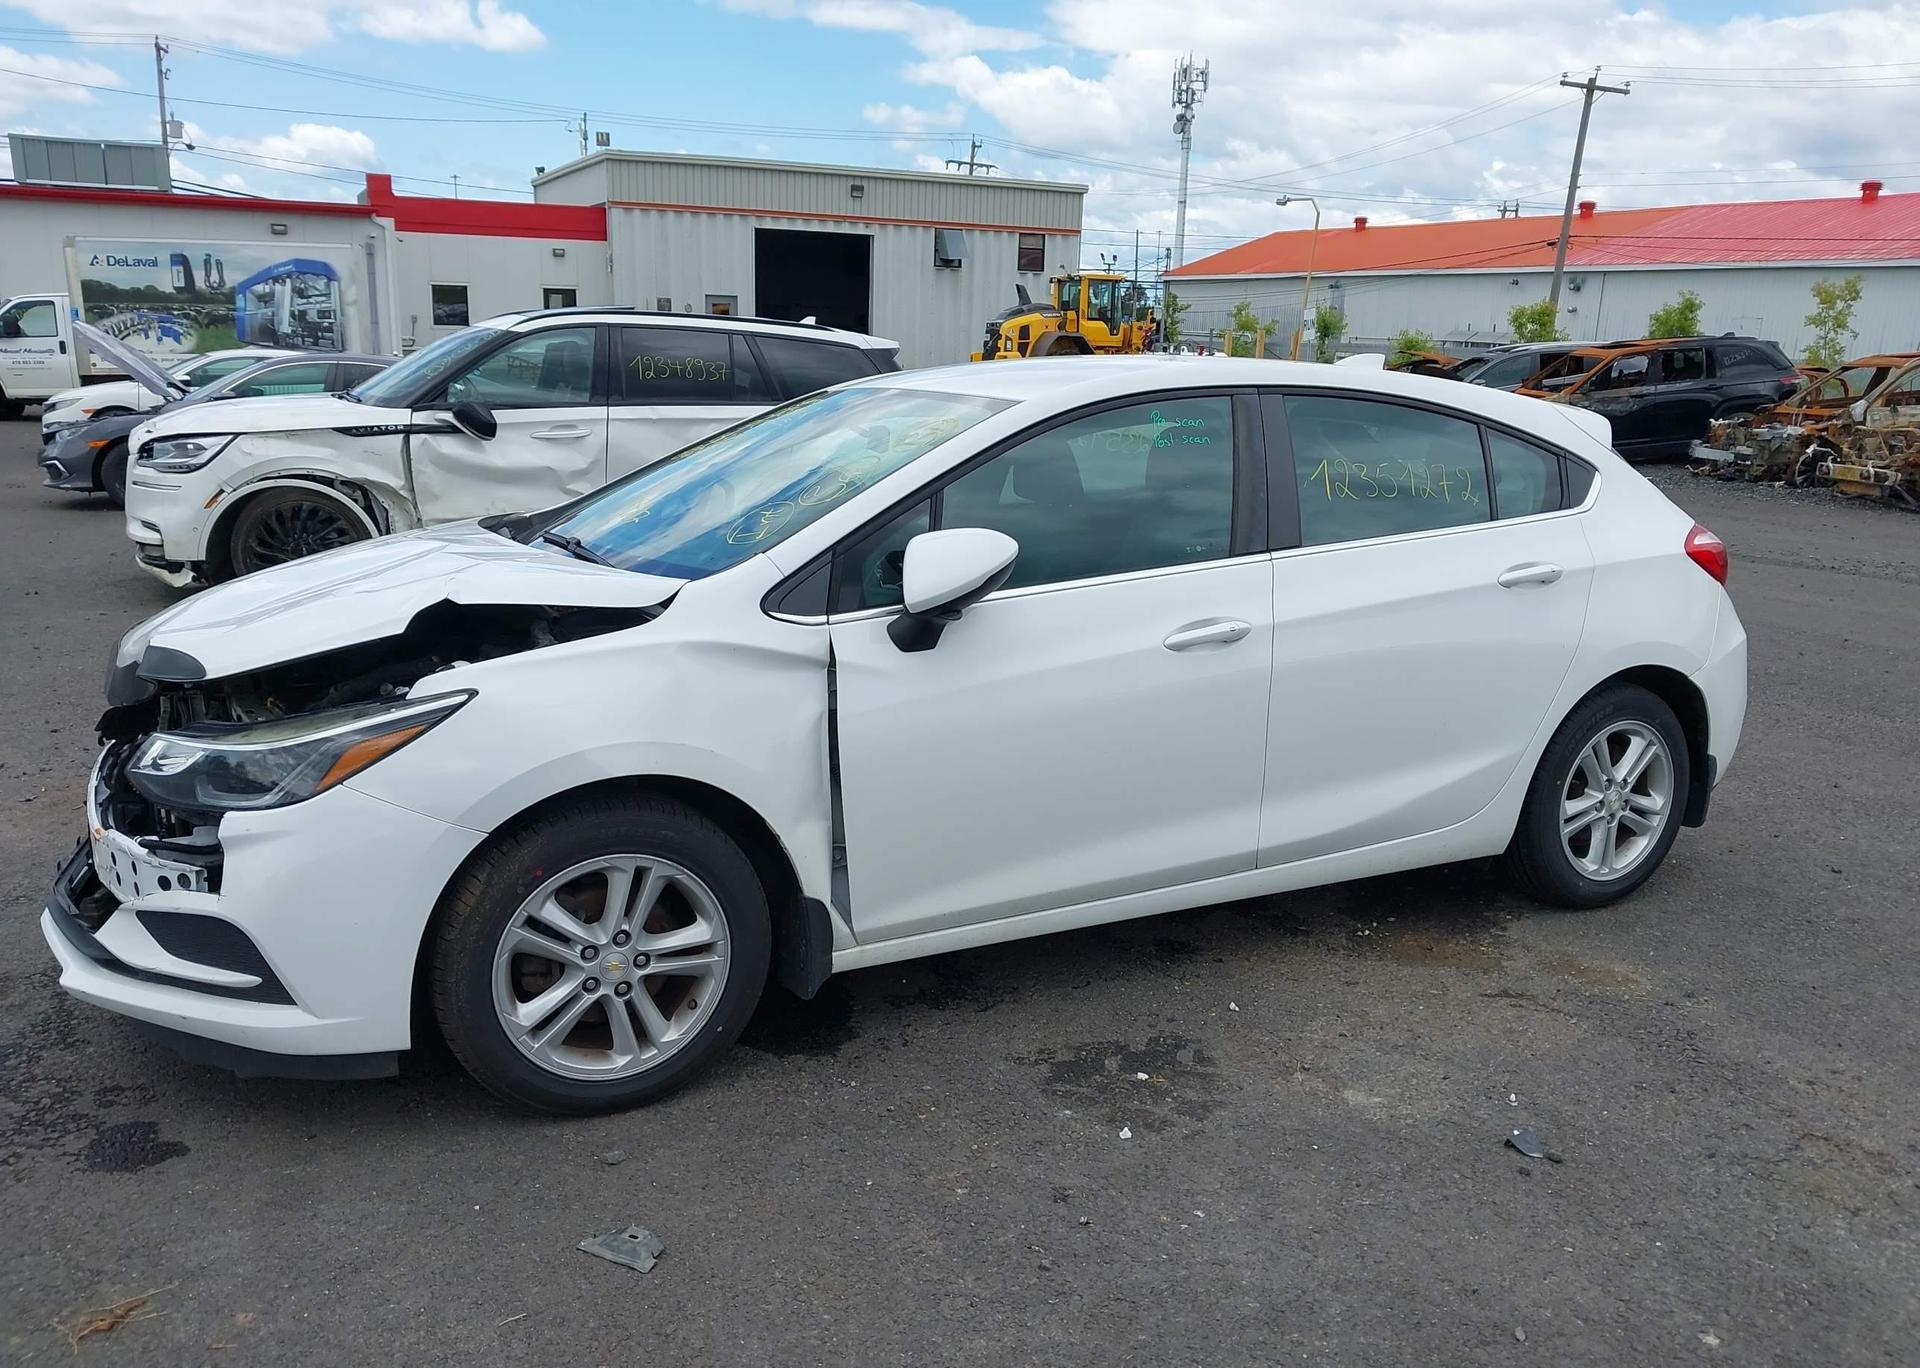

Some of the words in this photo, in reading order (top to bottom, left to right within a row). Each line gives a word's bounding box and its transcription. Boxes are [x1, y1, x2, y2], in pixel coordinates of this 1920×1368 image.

[106, 255, 158, 267] DeLaval
[629, 355, 731, 381] 12348937
[1176, 418, 1205, 427] scan
[351, 424, 404, 434] AVIATOR
[1182, 435, 1211, 445] scan
[1308, 458, 1480, 504] 12351272
